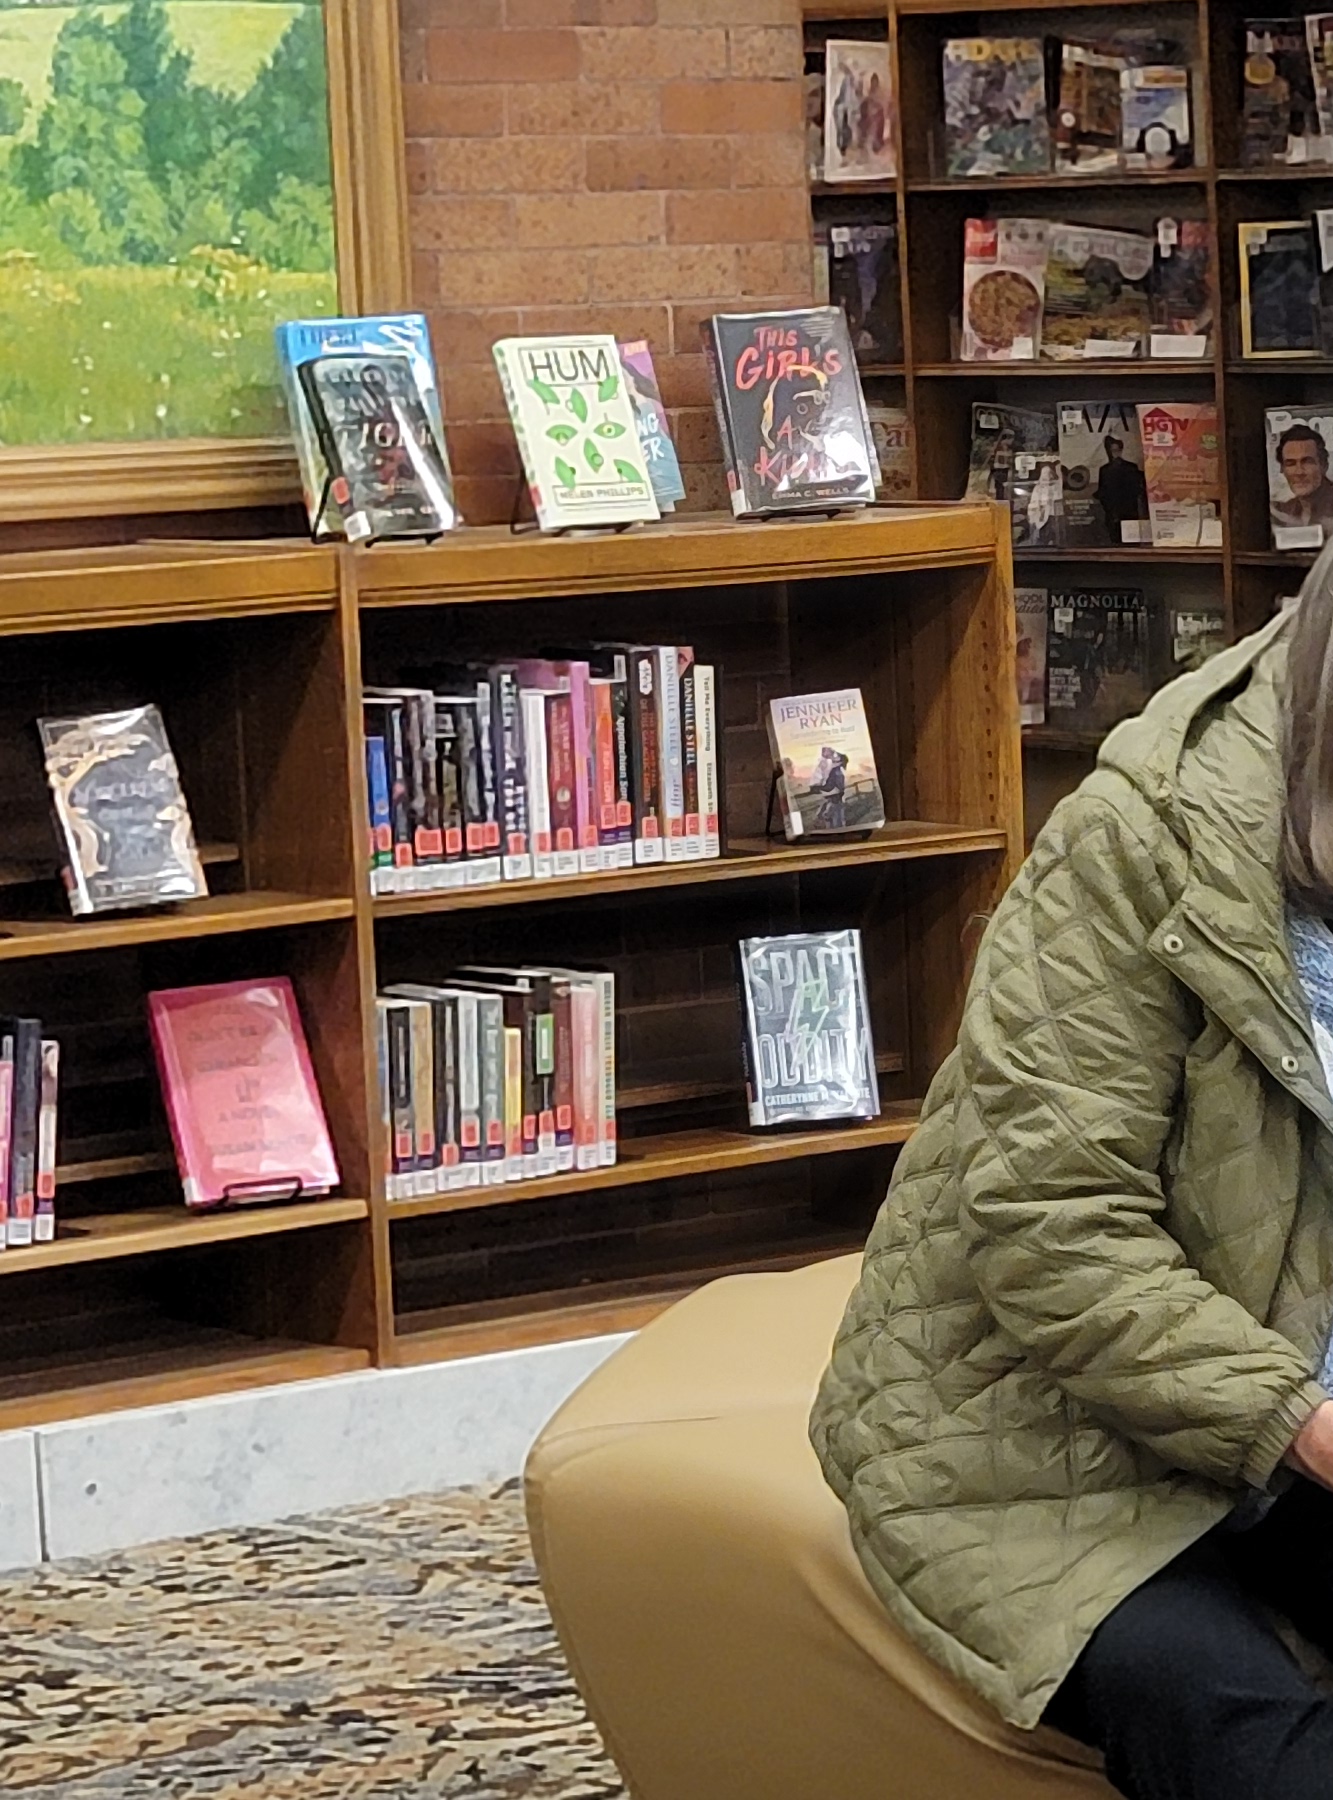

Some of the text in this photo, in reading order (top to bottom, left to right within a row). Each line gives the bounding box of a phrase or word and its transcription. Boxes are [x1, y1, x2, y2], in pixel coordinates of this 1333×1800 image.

[754, 326, 798, 351] THIS
[528, 349, 610, 382] HUM
[637, 412, 660, 436] NG
[777, 415, 798, 449] A
[1142, 417, 1190, 431] HGTV
[642, 437, 665, 461] ER
[560, 486, 644, 499] HELEN PHILLIPS
[817, 487, 850, 496] WELLS
[1050, 595, 1140, 608] MAGNOLIA
[665, 655, 676, 711] DANIELLE
[684, 678, 694, 731] DANIELLE
[704, 693, 710, 705] Me
[780, 699, 858, 722] JENNIFER
[800, 714, 842, 729] RYAN
[616, 715, 627, 779] Appalachian
[668, 718, 678, 752] STEEL
[685, 735, 695, 766] STEEL
[750, 946, 856, 1016] SPACE
